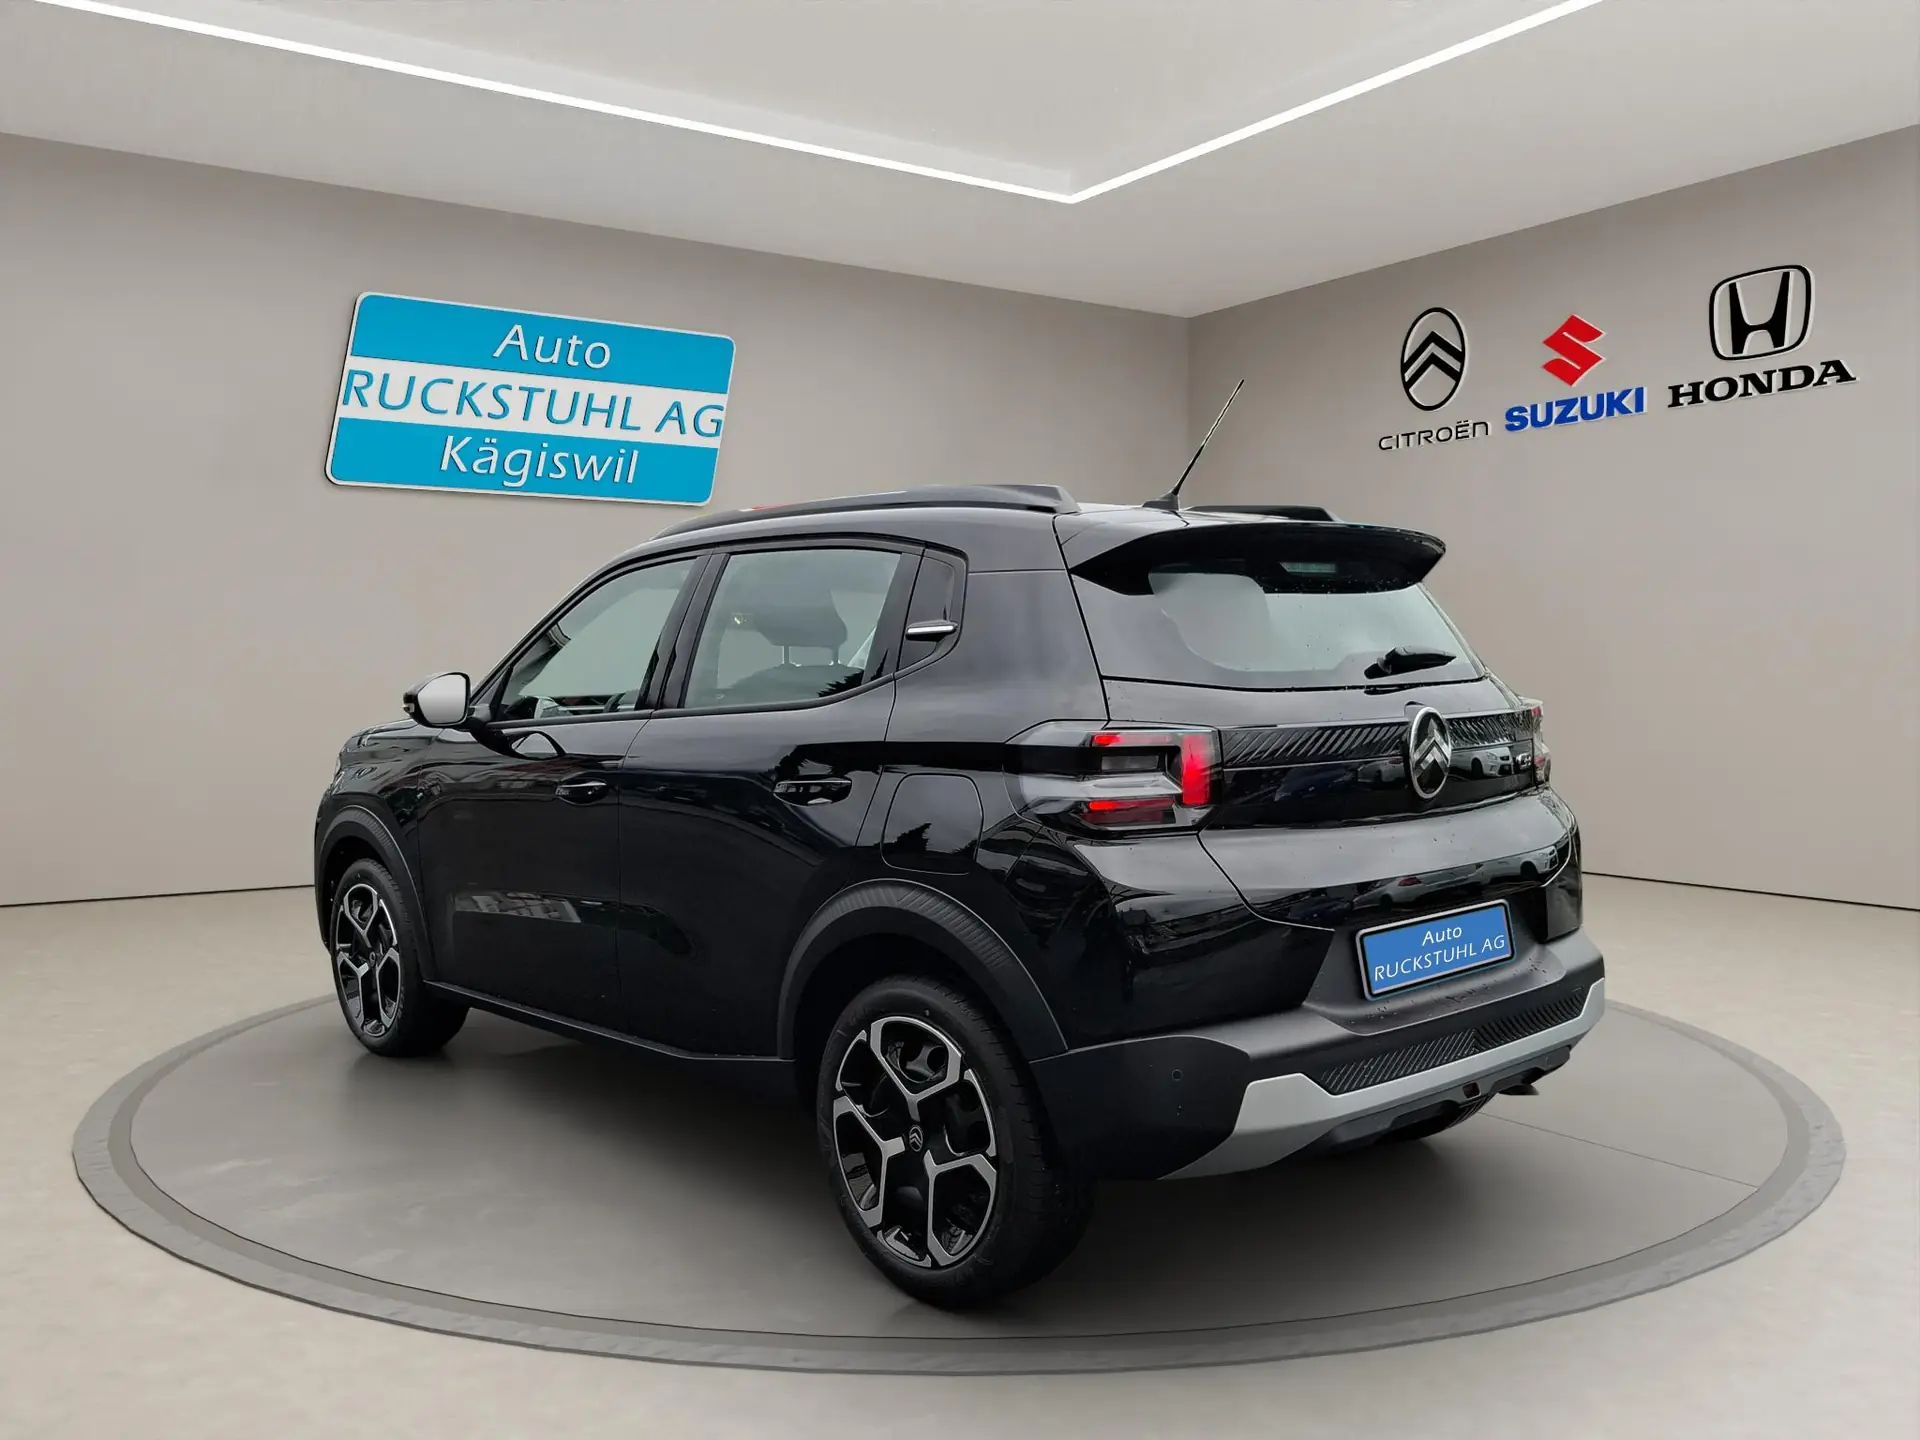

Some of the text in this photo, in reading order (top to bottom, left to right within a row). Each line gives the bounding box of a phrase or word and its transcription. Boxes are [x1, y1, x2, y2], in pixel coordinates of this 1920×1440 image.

[493, 324, 611, 369] Auto
[342, 369, 725, 438] RUCKSTUHL AG
[1667, 359, 1857, 408] HONDA
[1504, 387, 1645, 433] SUZUKI
[440, 435, 640, 487] Kägiswil
[1374, 934, 1505, 981] RUCKSTUHL AG
[1422, 927, 1462, 946] Auto
